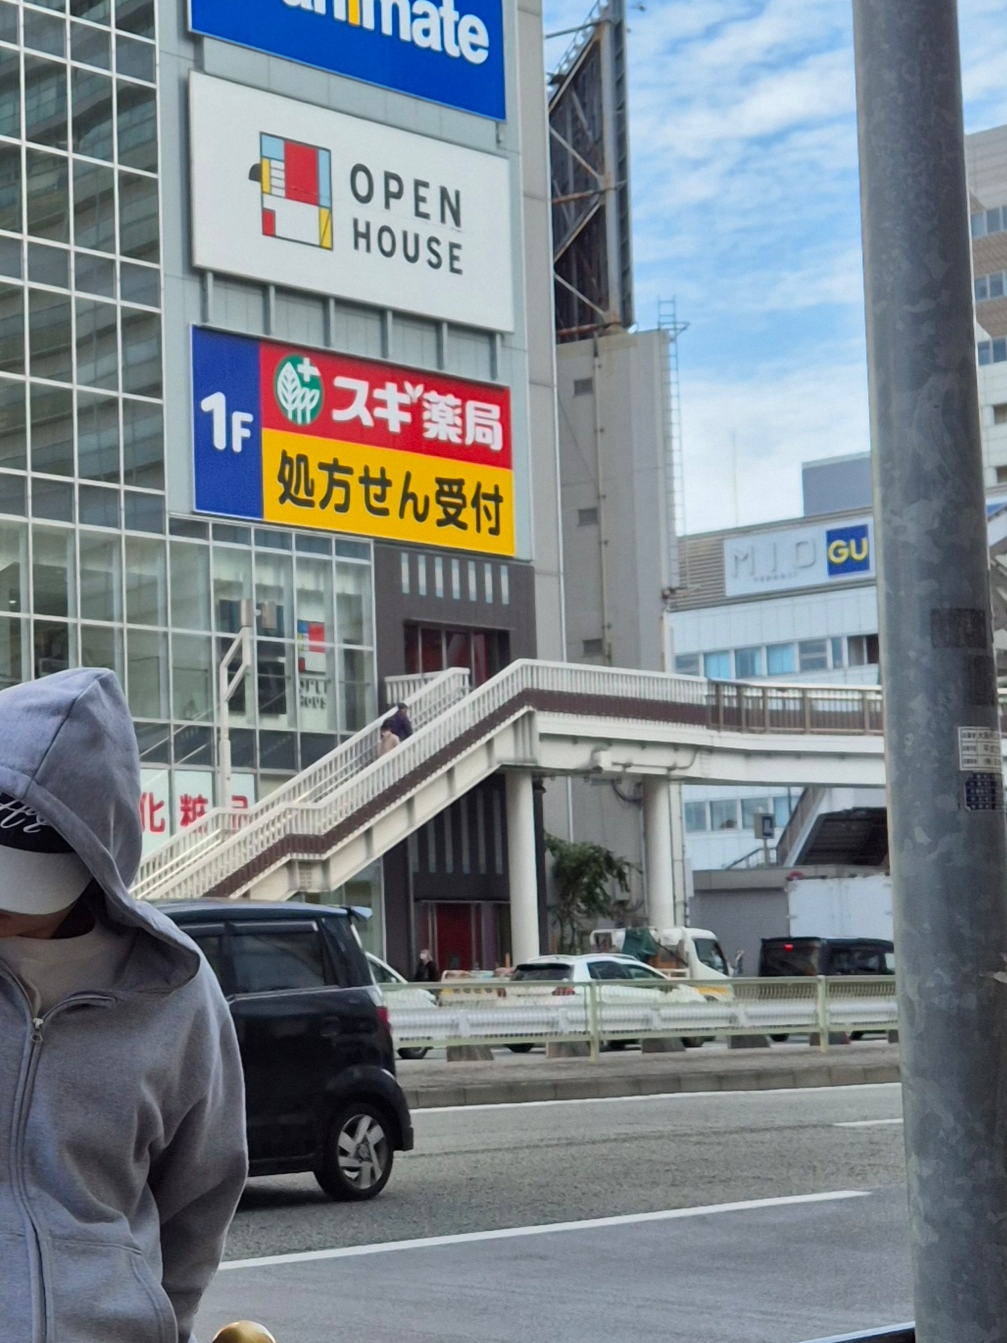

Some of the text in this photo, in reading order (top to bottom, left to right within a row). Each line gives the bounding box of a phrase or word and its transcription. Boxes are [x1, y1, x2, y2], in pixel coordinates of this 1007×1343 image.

[282, 0, 490, 65] mate
[349, 162, 463, 229] OPEN
[352, 217, 464, 276] HOUSE
[200, 391, 254, 453] 1F
[331, 376, 504, 452] スギ薬局
[277, 449, 504, 536] 処方せん受付
[828, 537, 869, 564] GU
